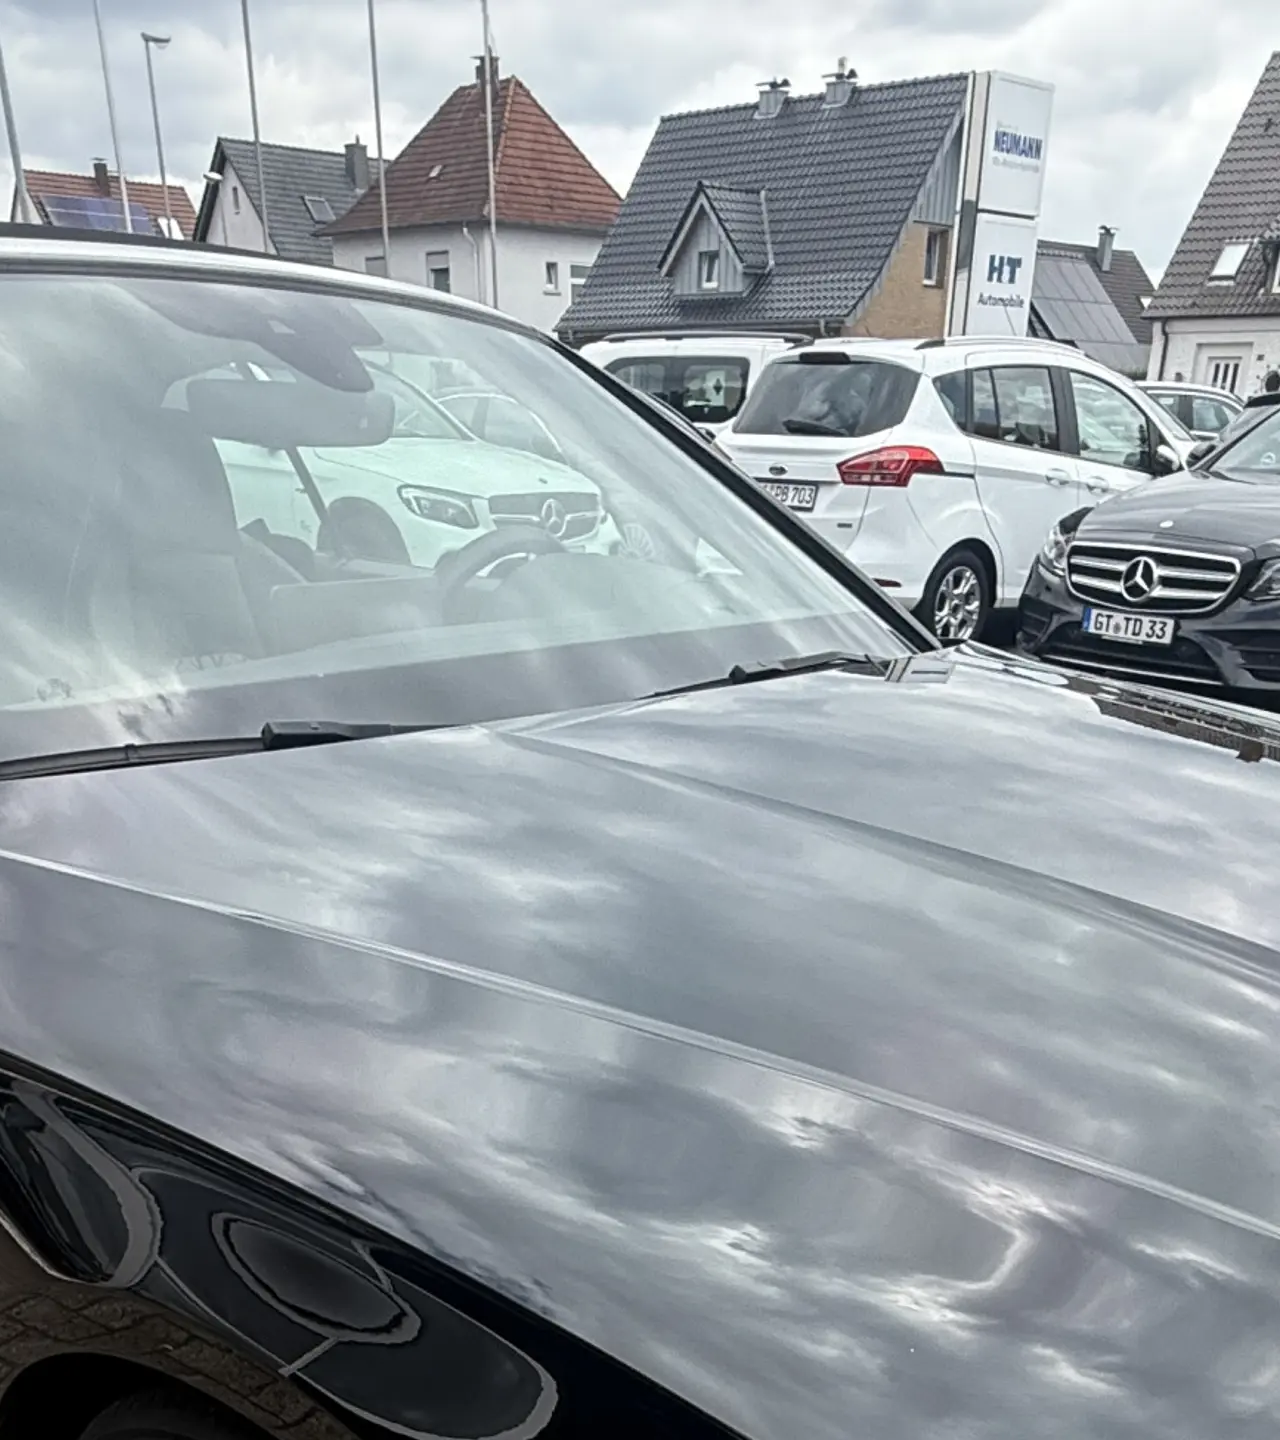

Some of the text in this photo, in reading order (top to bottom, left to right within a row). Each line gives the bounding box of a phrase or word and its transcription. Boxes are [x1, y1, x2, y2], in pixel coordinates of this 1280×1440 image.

[993, 130, 1043, 160] NEUMANN
[987, 254, 1022, 284] HT
[790, 487, 814, 504] 703
[1094, 612, 1168, 640] GT TD 33
